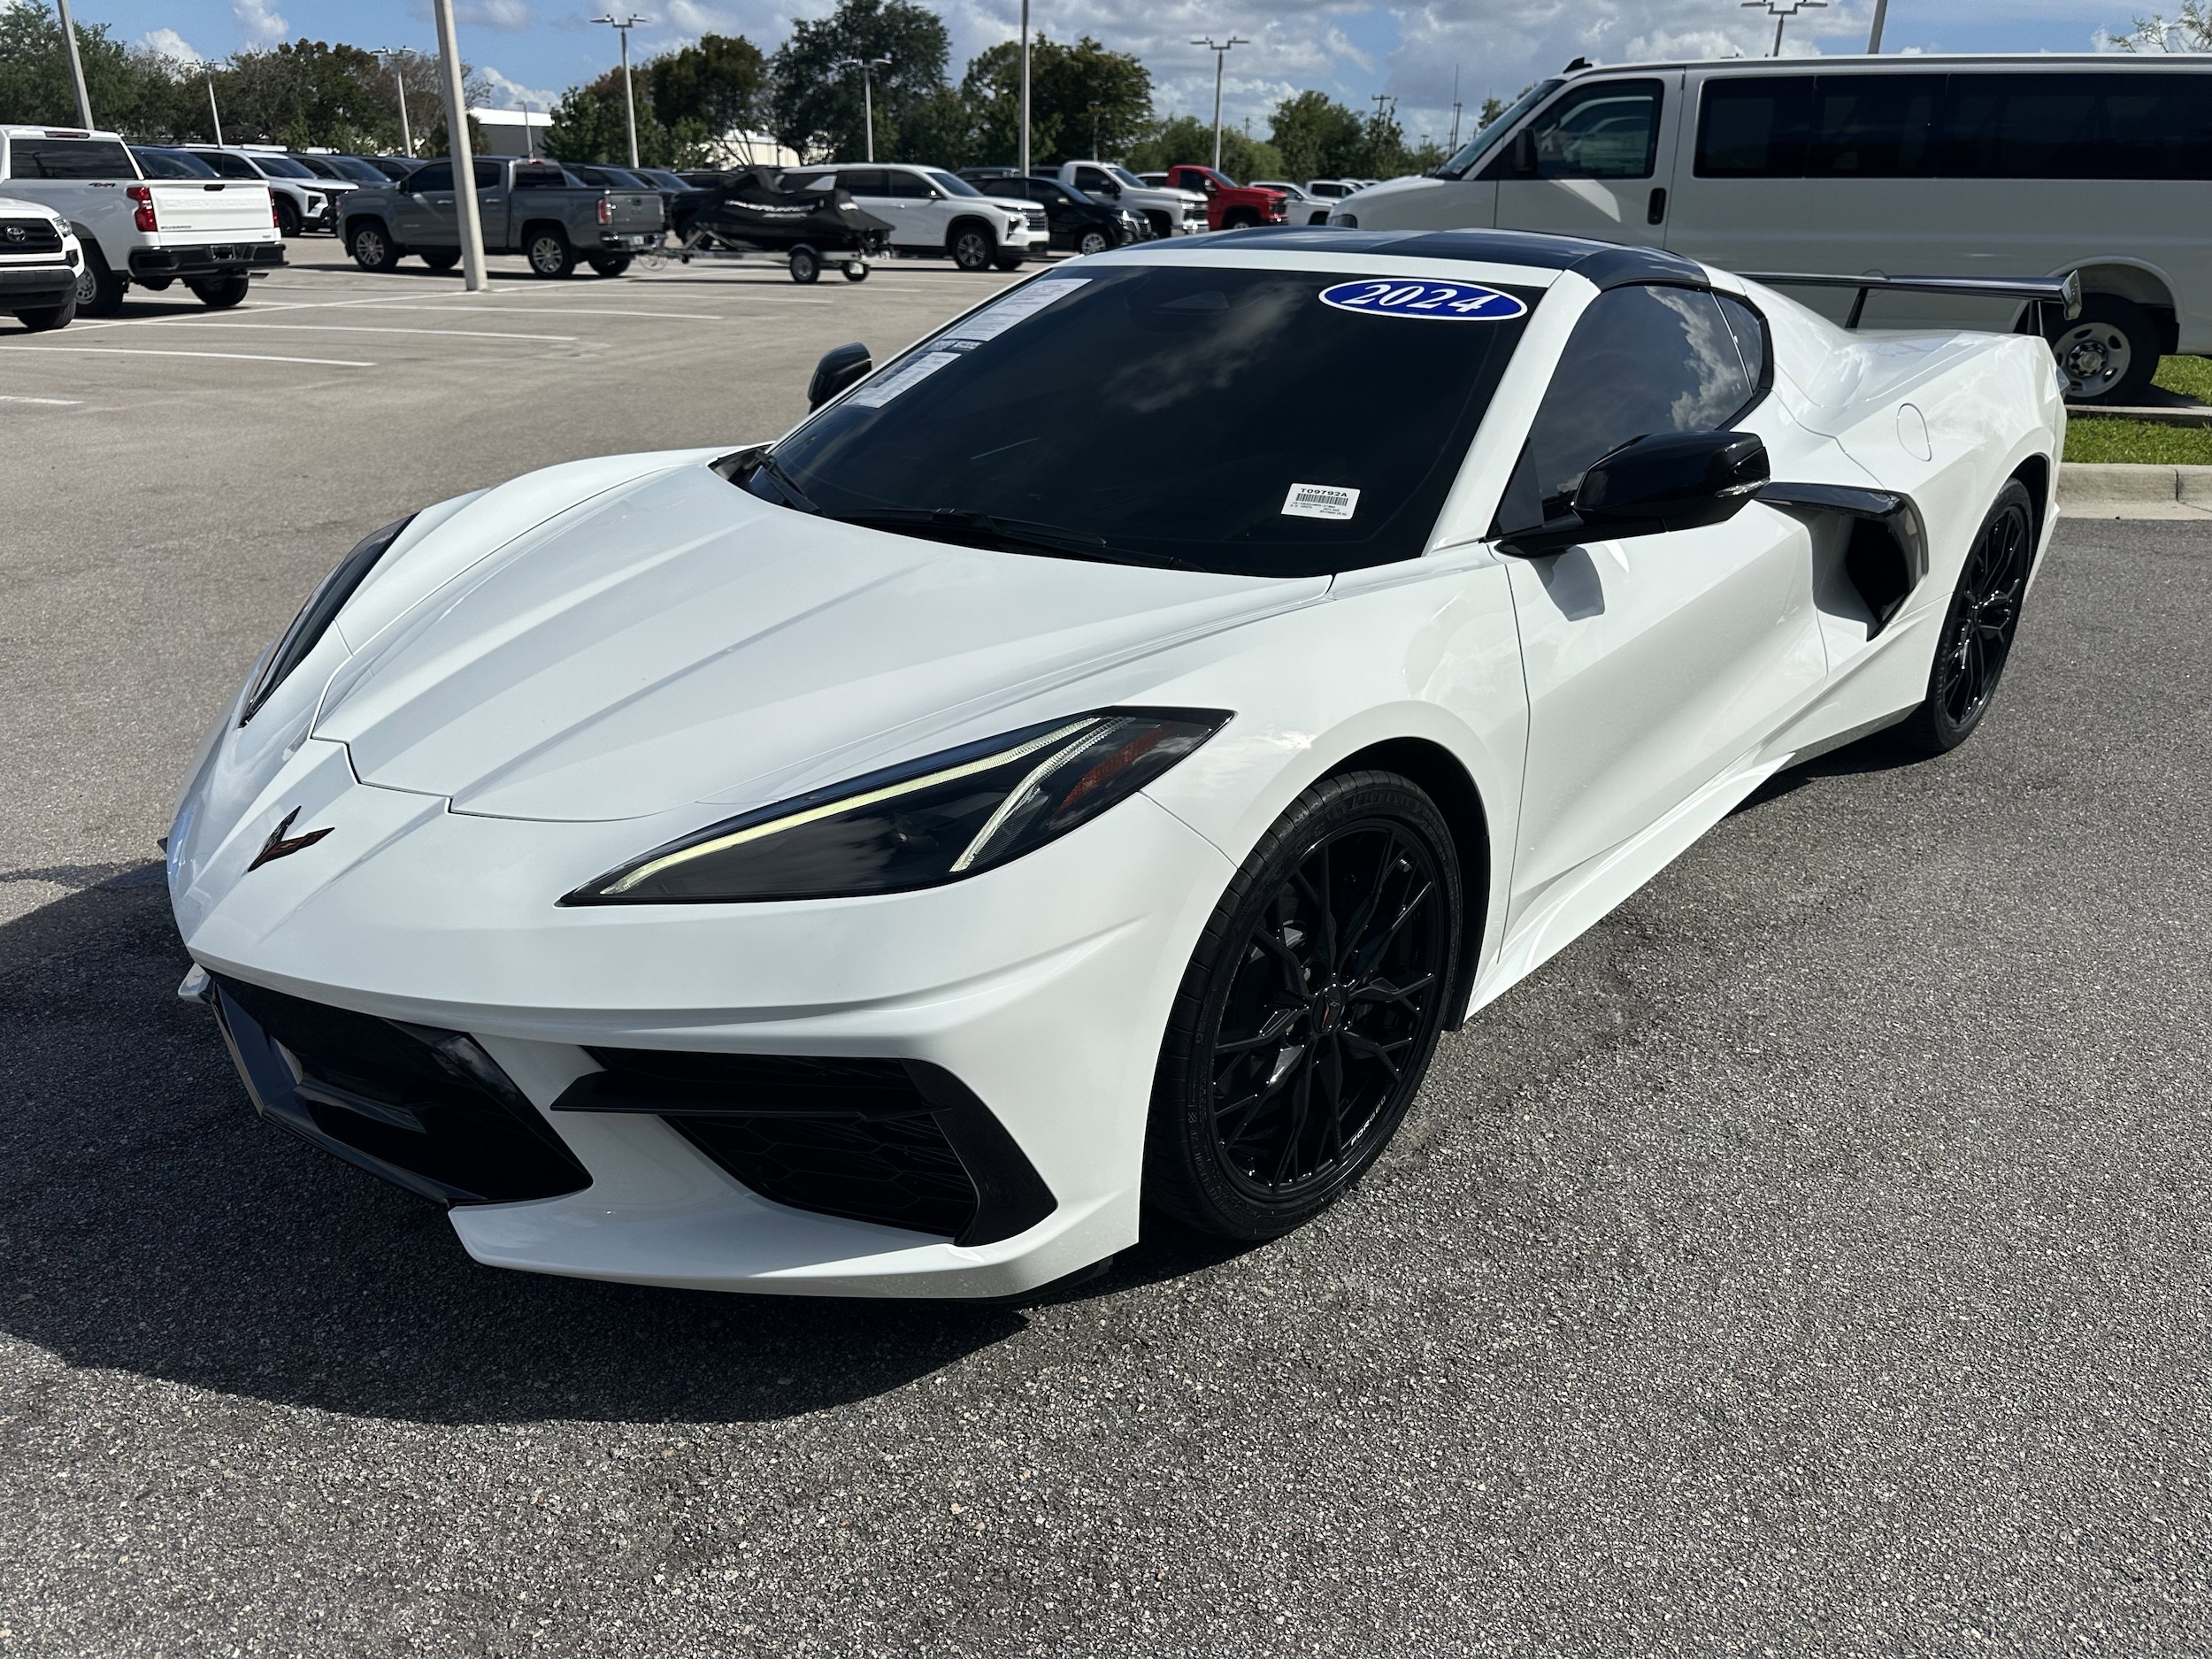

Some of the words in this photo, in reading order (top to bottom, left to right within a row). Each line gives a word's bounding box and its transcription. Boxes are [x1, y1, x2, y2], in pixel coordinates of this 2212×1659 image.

[164, 197, 264, 209] CHEVROLET
[1340, 283, 1501, 313] 2024
[1301, 488, 1348, 497] T09792A
[1350, 1094, 1386, 1147] FORGED
